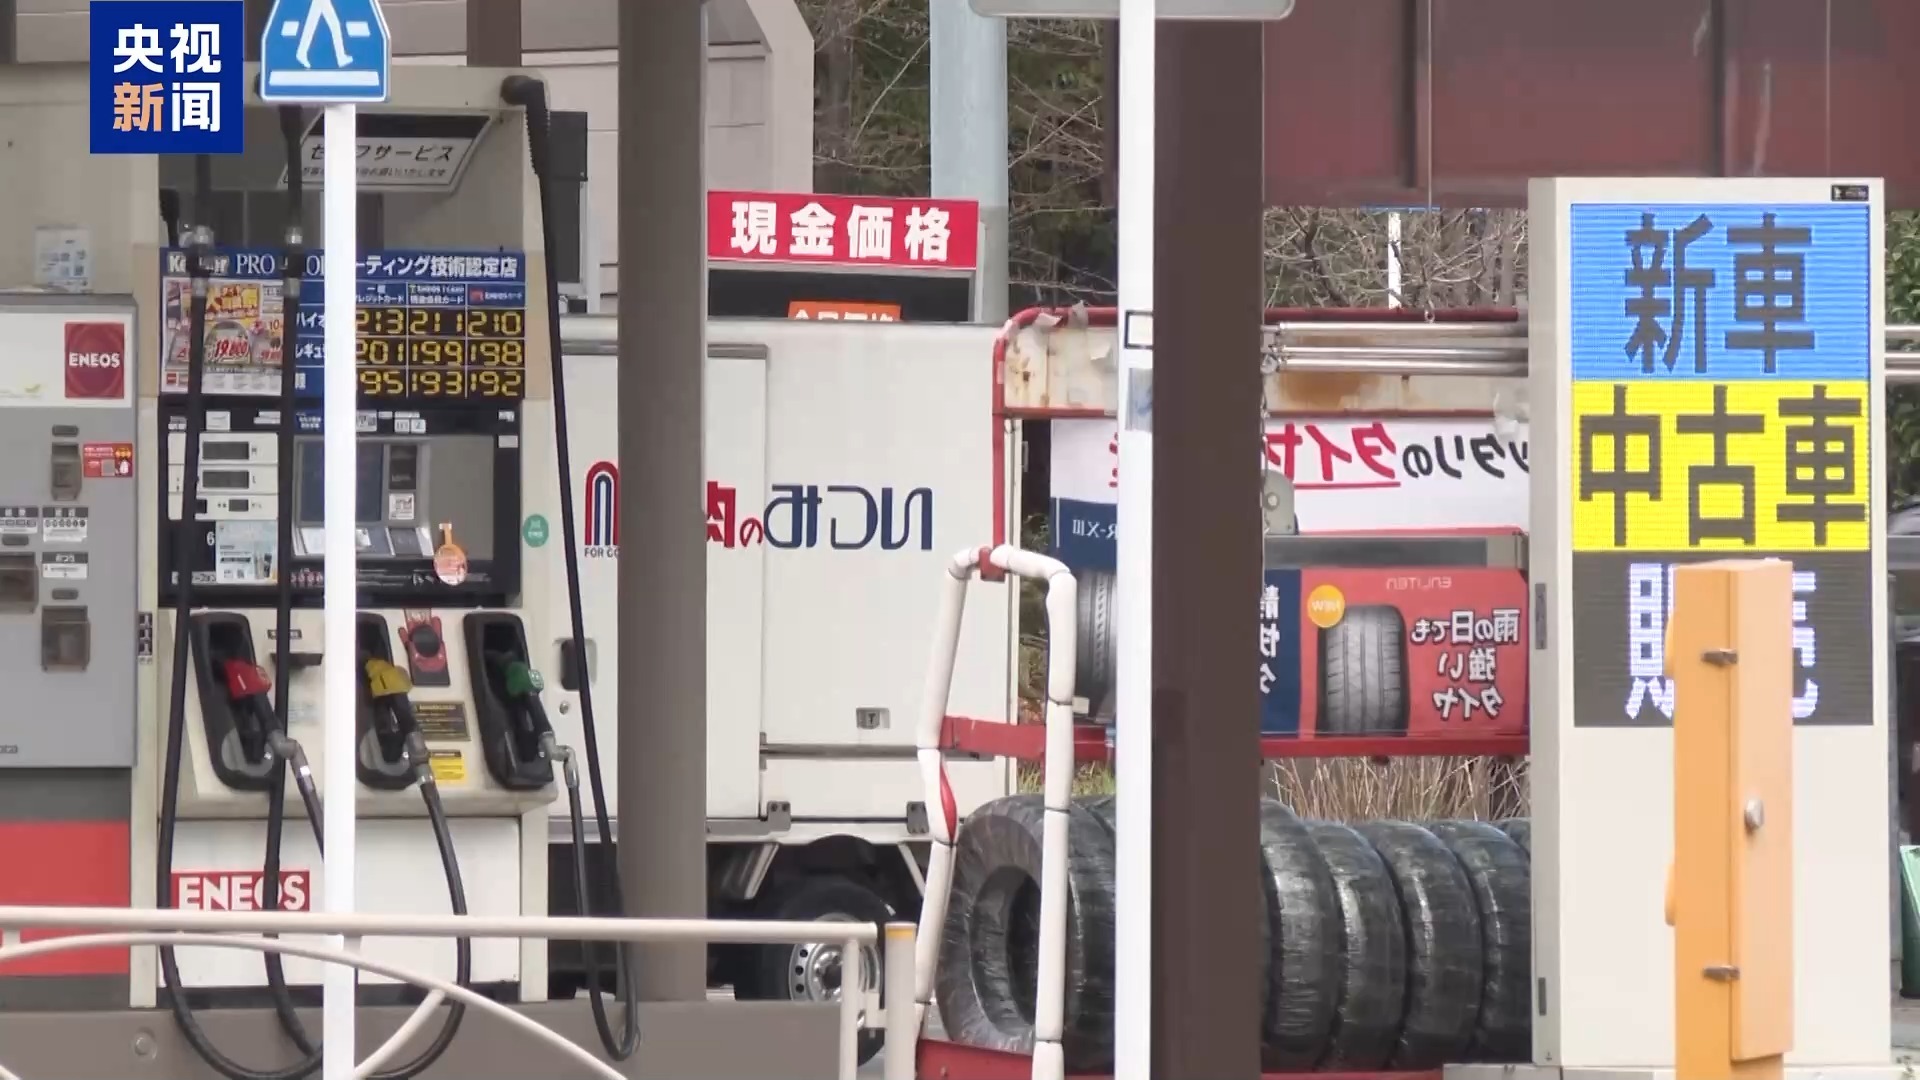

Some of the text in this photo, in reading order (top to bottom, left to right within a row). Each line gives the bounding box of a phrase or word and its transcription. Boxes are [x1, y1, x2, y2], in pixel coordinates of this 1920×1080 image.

[311, 144, 454, 162] セフサービス
[730, 201, 951, 260] 現金価格
[236, 253, 275, 275] PRO
[1624, 212, 1816, 373] 新車
[356, 309, 404, 335] 213
[410, 309, 463, 335] 211
[468, 311, 522, 336] 210
[69, 353, 120, 368] ENEOS
[412, 341, 462, 367] 199
[471, 341, 523, 366] 198
[359, 371, 522, 396] 95 193 192
[1579, 384, 1869, 546] 中古車
